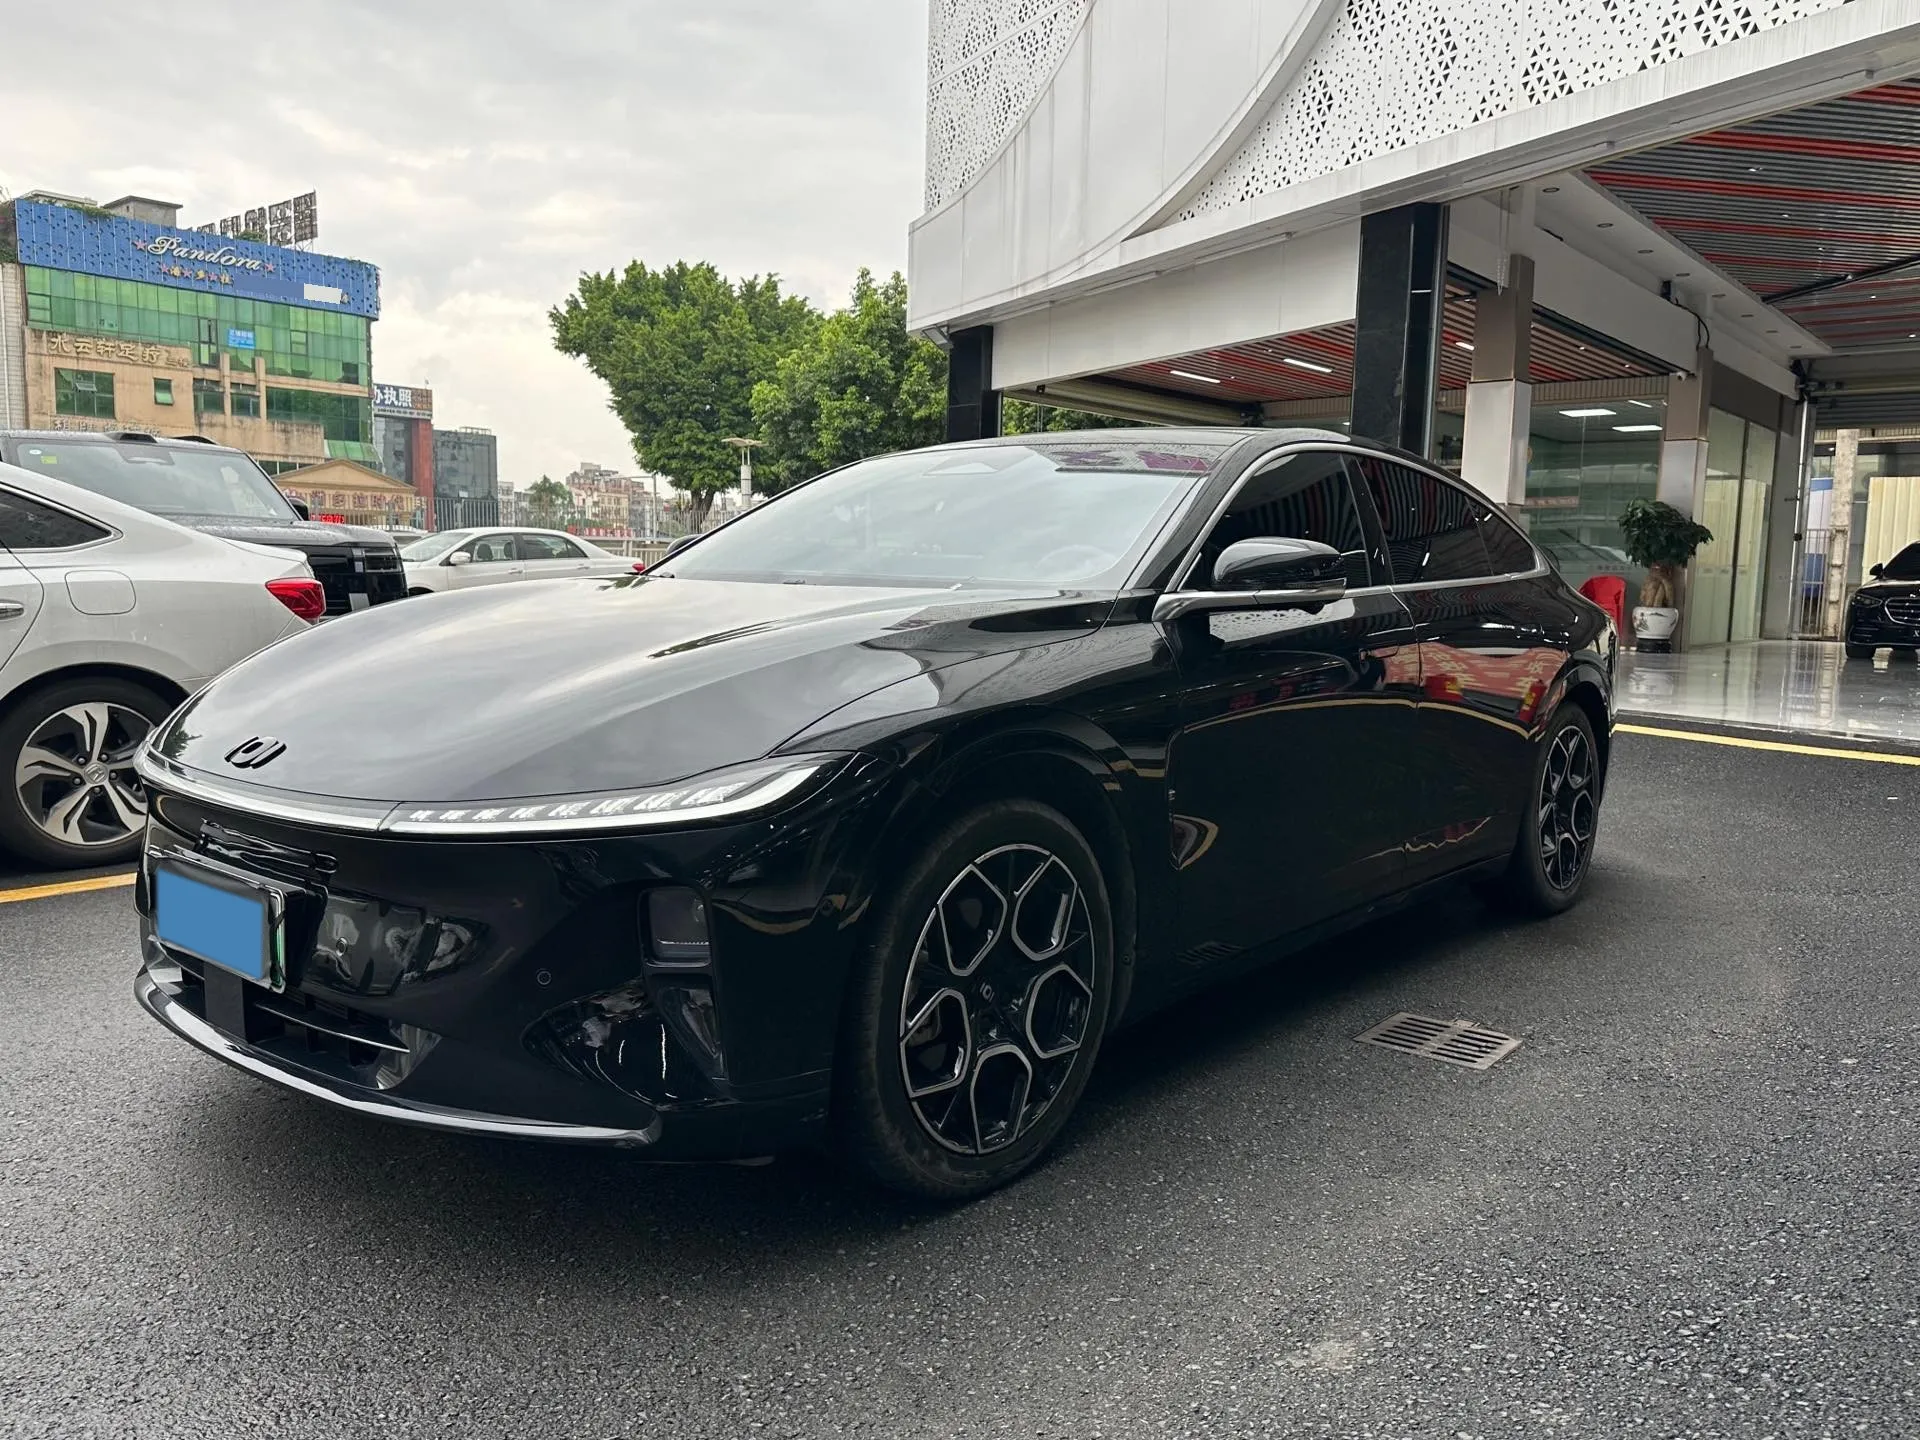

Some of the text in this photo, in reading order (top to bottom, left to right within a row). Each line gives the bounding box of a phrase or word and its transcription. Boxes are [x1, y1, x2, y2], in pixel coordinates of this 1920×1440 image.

[147, 236, 261, 270] Pandora
[50, 334, 161, 363] 水云轩足疗
